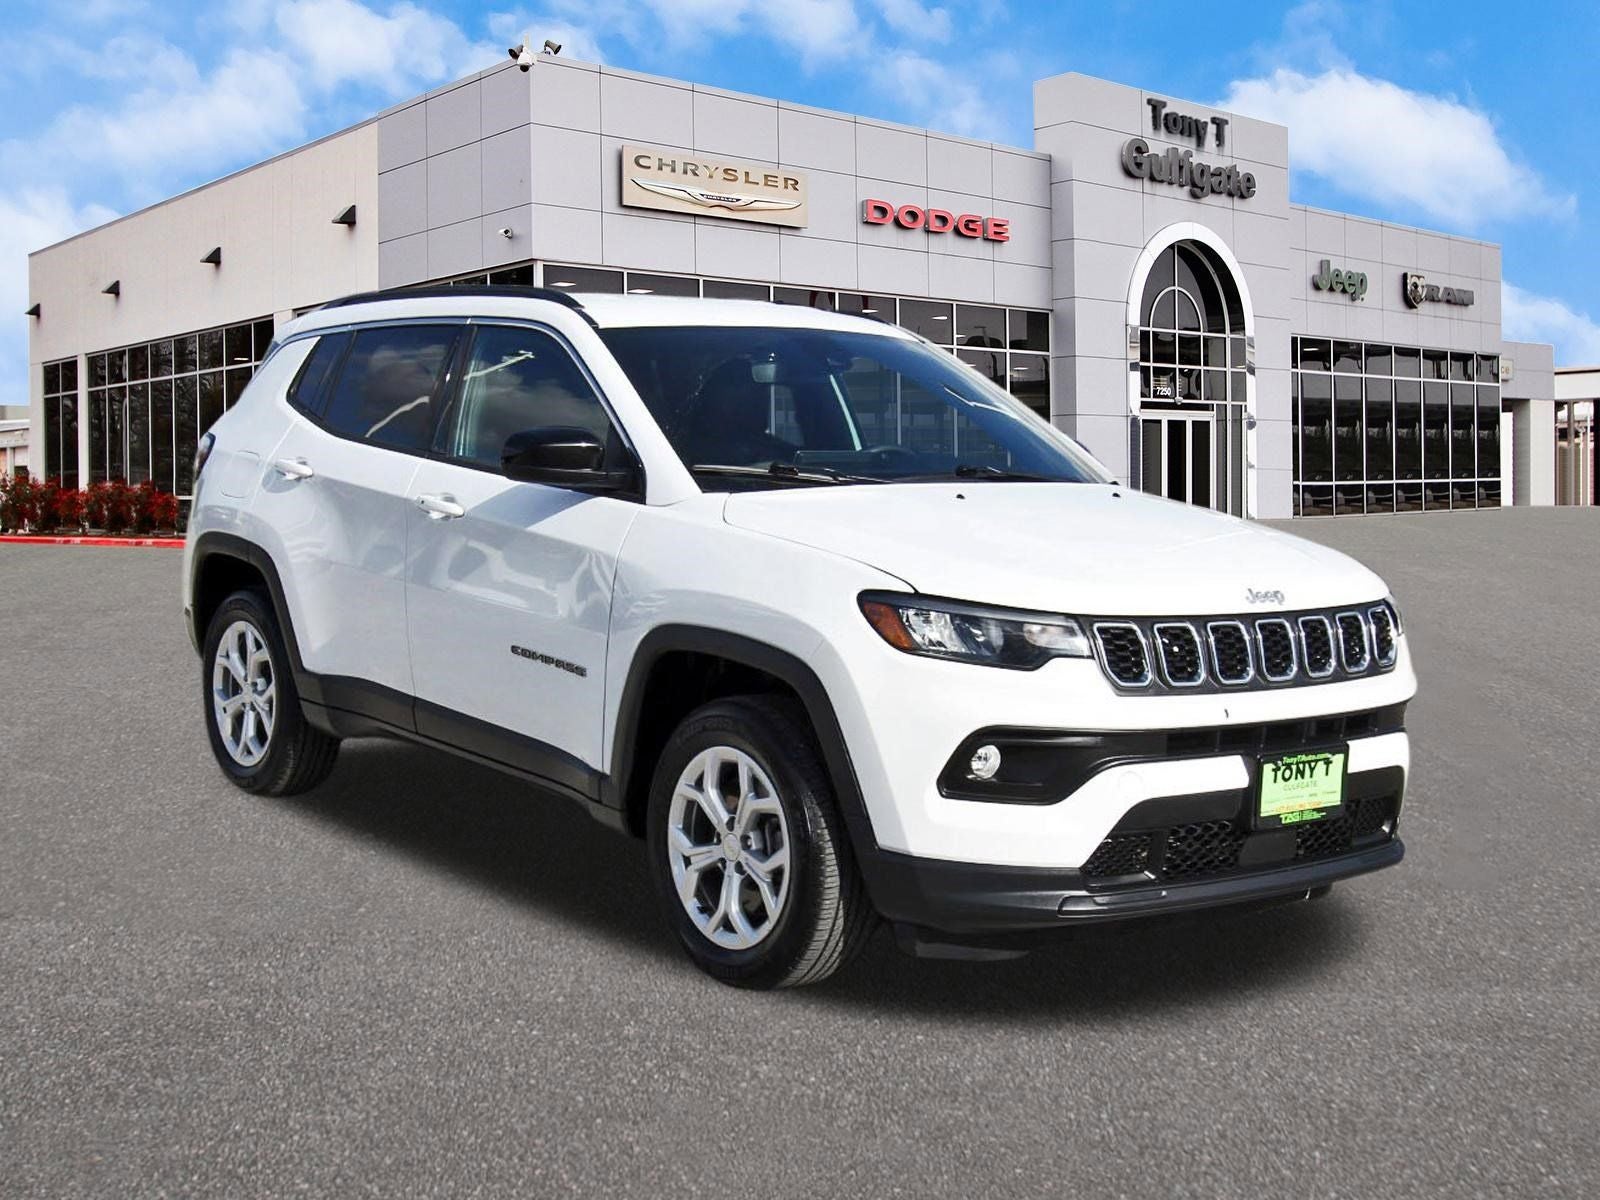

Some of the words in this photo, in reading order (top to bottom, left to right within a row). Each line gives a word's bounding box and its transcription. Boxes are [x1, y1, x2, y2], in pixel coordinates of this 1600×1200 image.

[1147, 98, 1208, 147] Tony
[1211, 116, 1229, 147] T
[634, 154, 799, 191] CHRYSLER
[1121, 138, 1256, 199] Gulfgate
[863, 199, 1010, 242] DODGE
[1312, 259, 1368, 301] Jeep
[1425, 284, 1474, 306] RAM
[1156, 387, 1172, 396] 7250
[1245, 588, 1285, 605] Jeep
[511, 645, 587, 677] COMPASS
[1271, 760, 1320, 784] TONY
[1323, 759, 1333, 776] T
